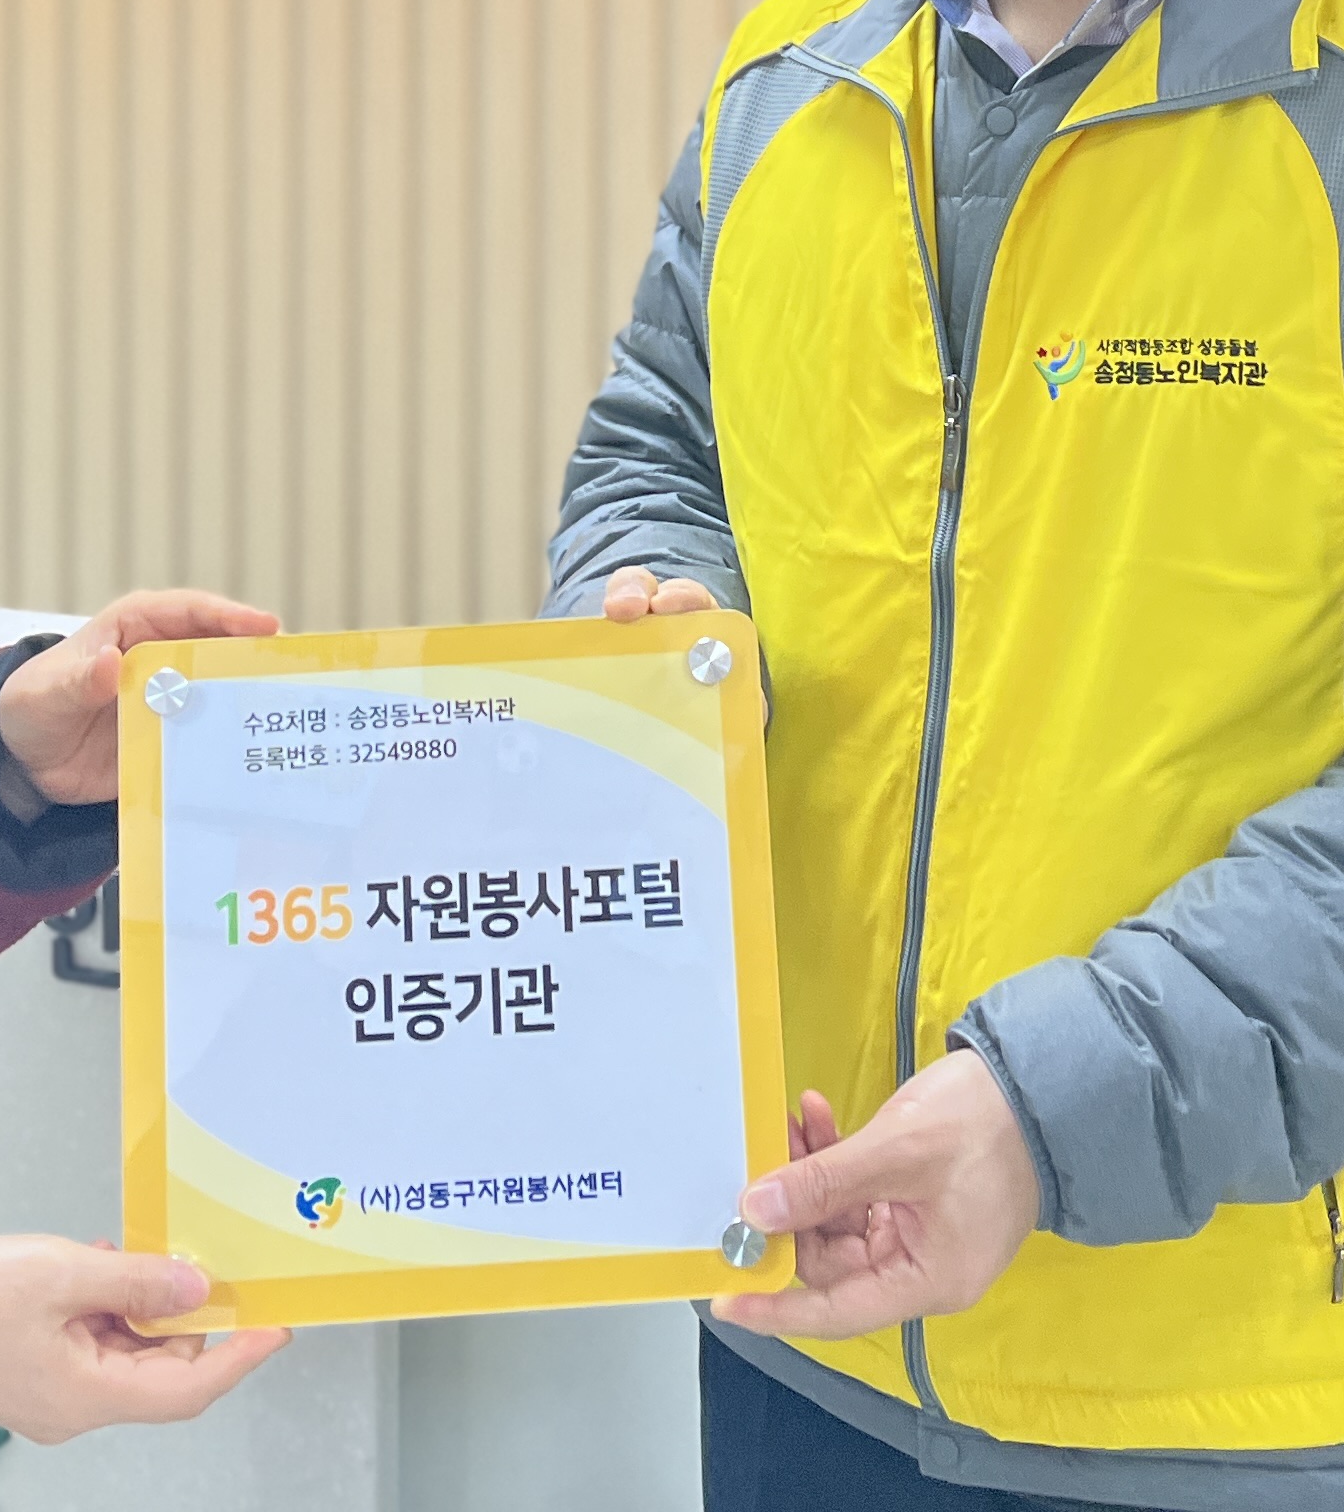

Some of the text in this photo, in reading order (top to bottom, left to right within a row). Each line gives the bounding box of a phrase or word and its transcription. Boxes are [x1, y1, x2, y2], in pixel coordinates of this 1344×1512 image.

[1094, 359, 1268, 386] 송정동노인복지관
[243, 707, 327, 737] 수요처명
[347, 697, 516, 731] 송정동노인복지관
[243, 744, 329, 773] 등록번호
[348, 738, 457, 765] 32549880
[214, 859, 684, 947] 1365 자원봉사포털
[343, 964, 560, 1043] 인증기관
[360, 1170, 624, 1215] (사)성동구자원봉사센터
